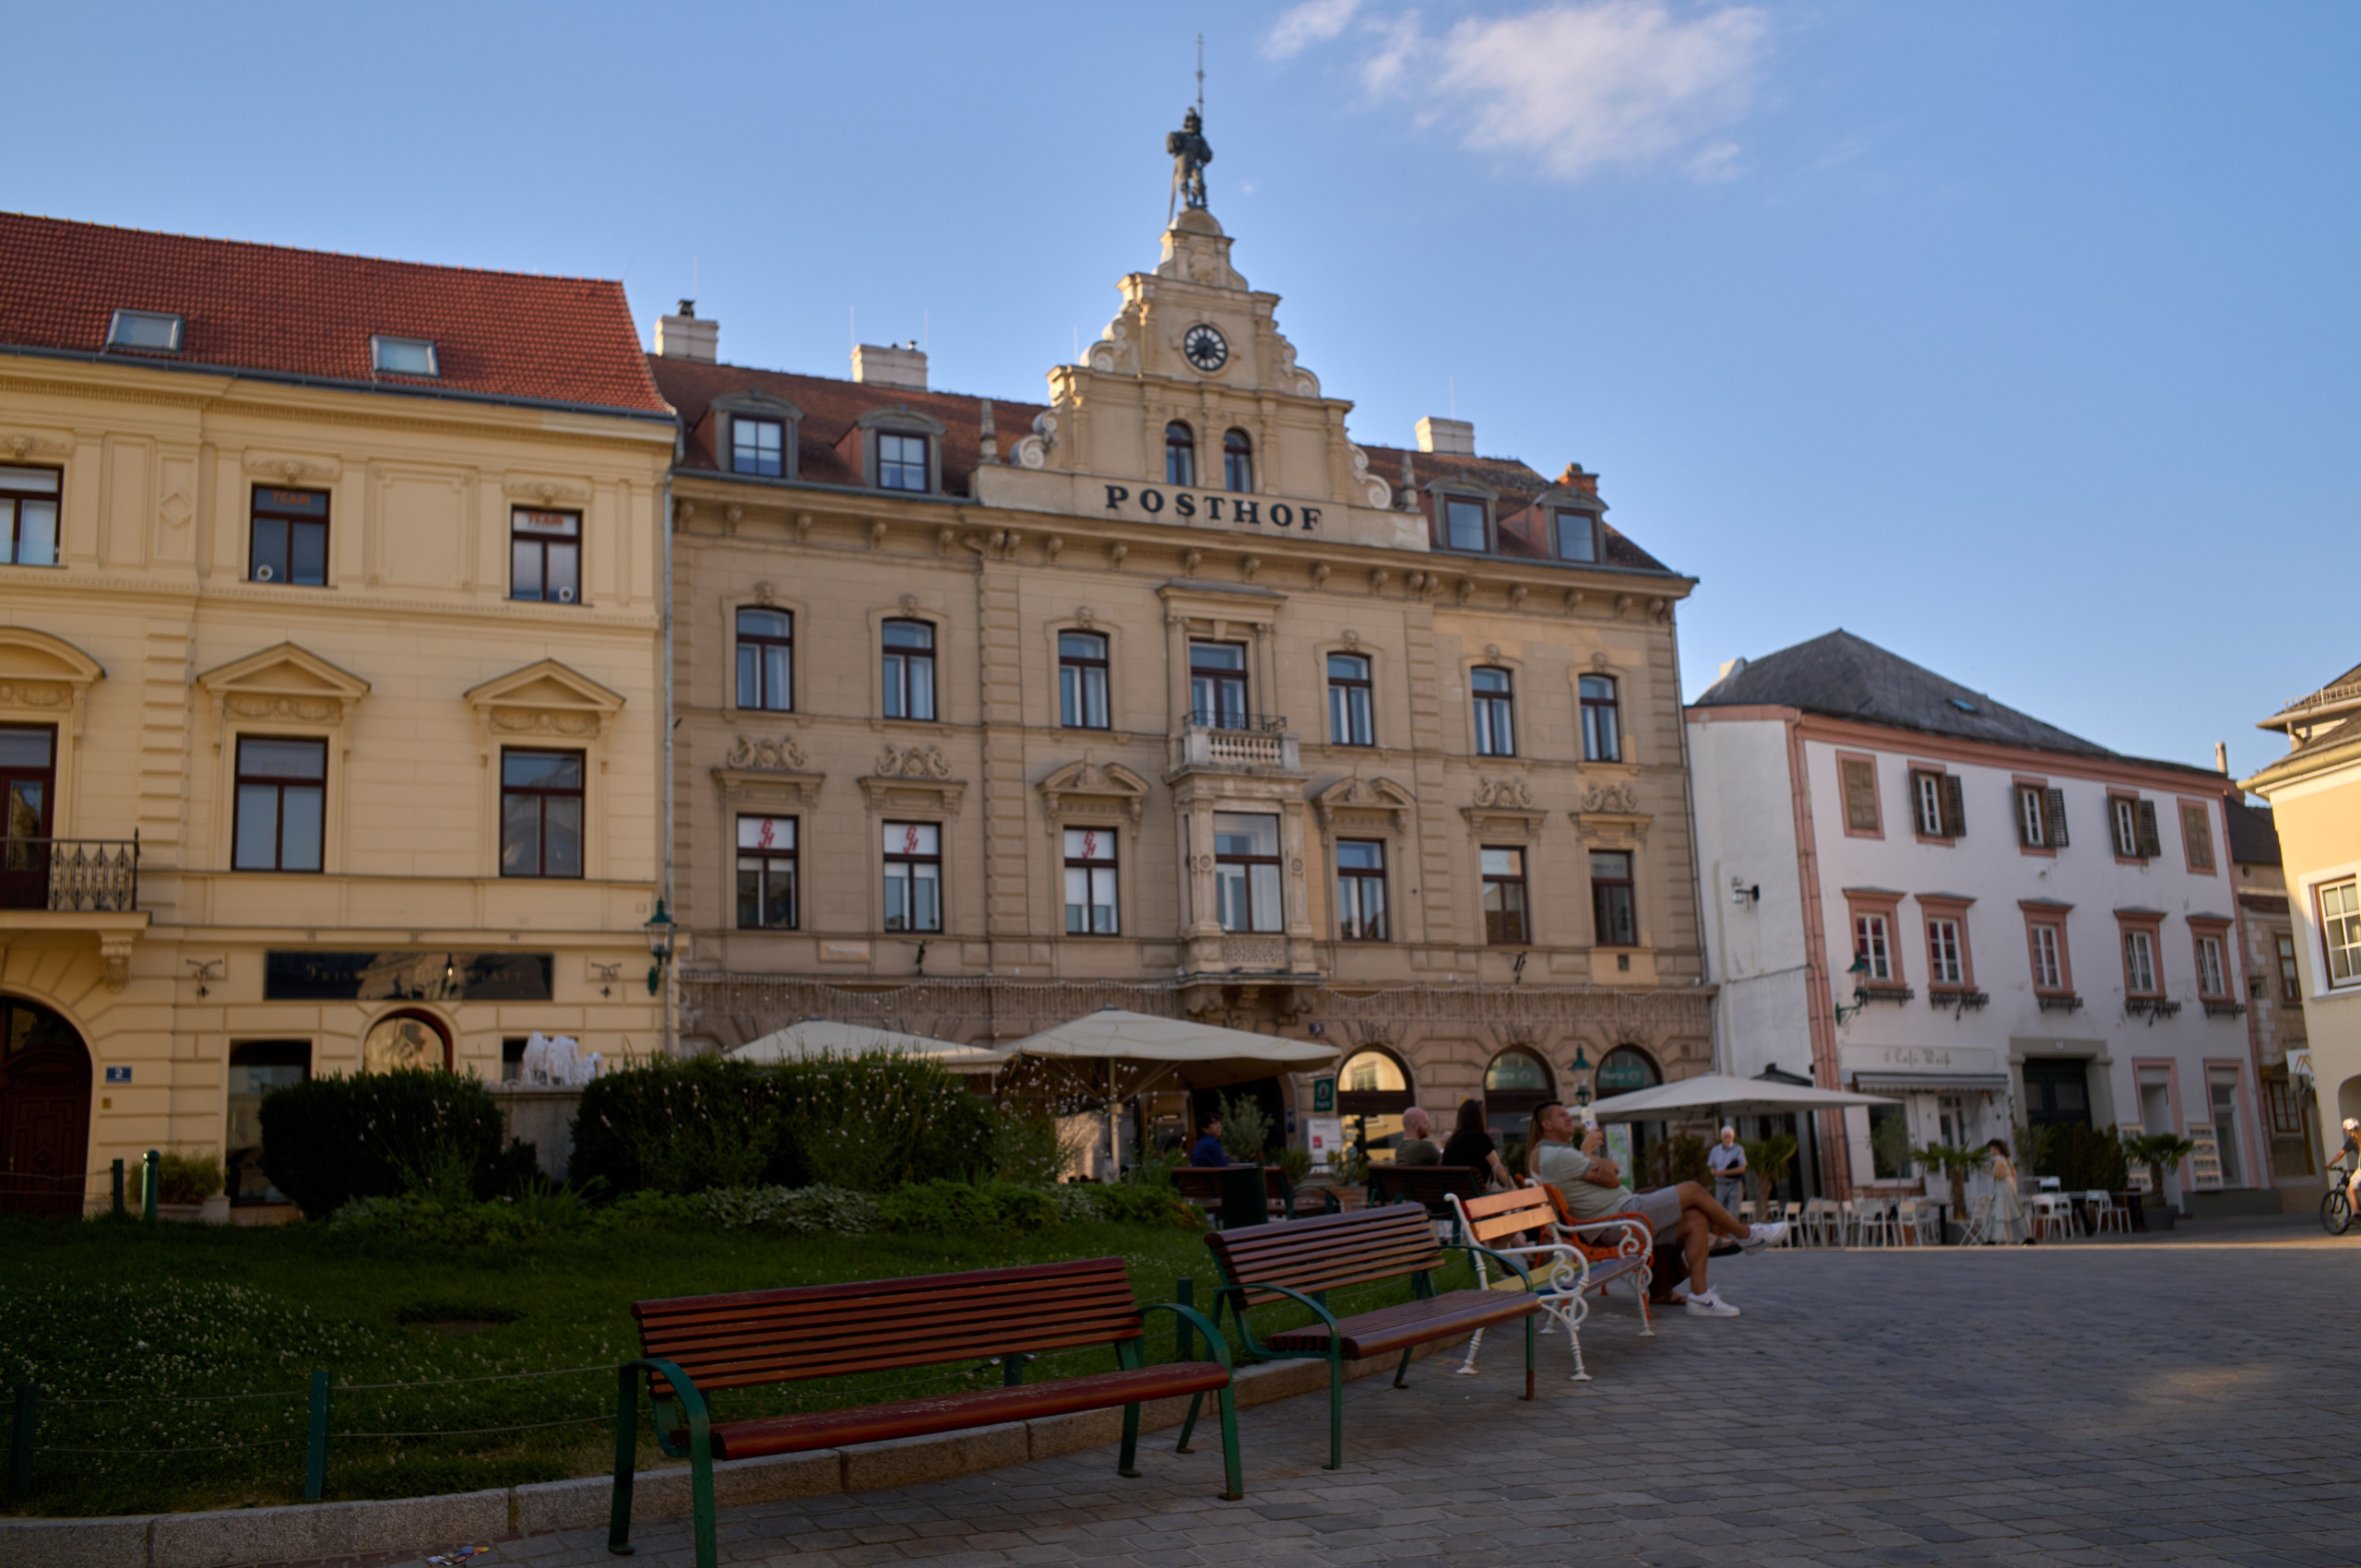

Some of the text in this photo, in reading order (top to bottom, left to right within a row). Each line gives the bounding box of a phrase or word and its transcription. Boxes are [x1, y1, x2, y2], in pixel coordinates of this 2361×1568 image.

[271, 491, 311, 505] TEAM
[1105, 485, 1322, 530] POSTHOF
[528, 512, 564, 527] TEAM
